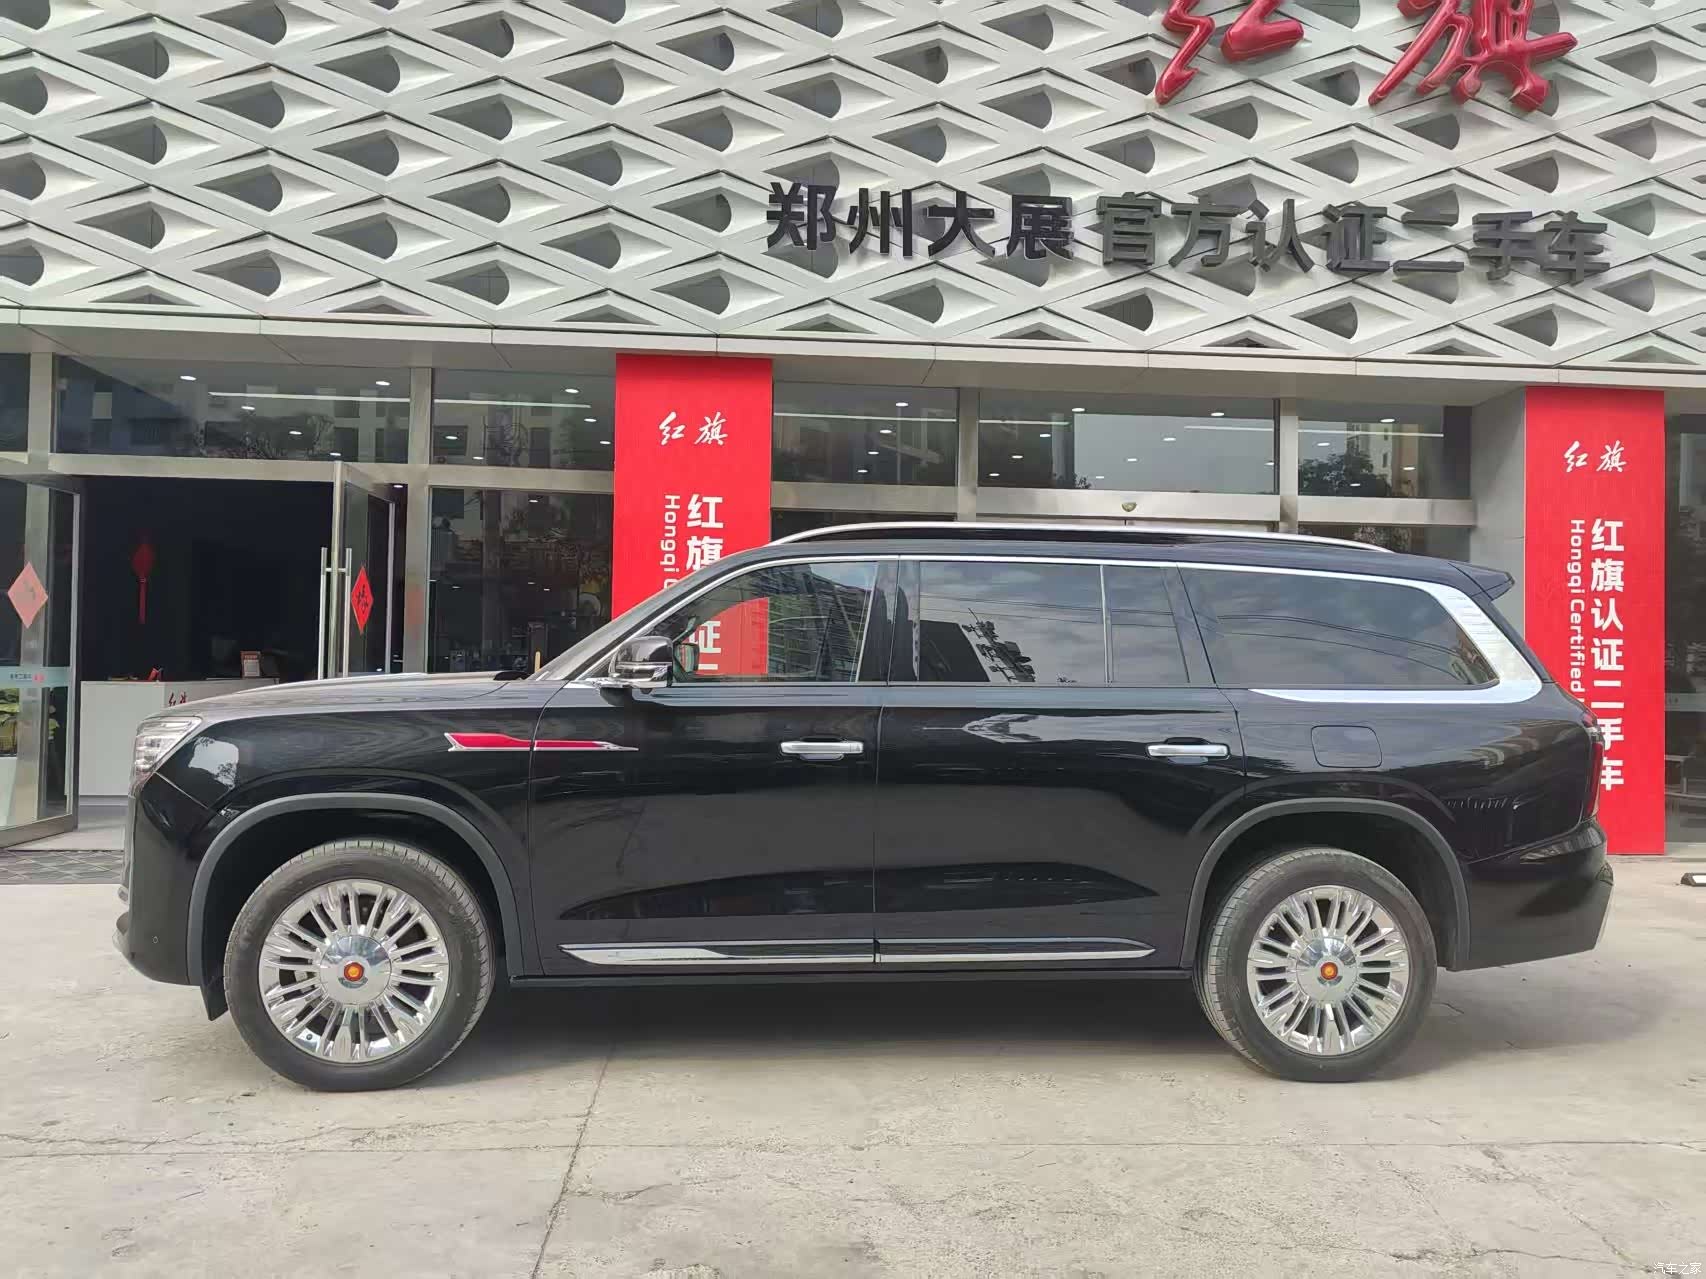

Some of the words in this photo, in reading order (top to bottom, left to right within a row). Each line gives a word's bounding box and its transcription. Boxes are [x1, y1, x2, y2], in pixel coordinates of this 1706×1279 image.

[659, 411, 728, 445] 红旗
[1564, 440, 1627, 472] 红旗
[660, 495, 680, 572] Hongqi
[1567, 519, 1585, 594] Hongqi
[1570, 599, 1585, 692] Certified
